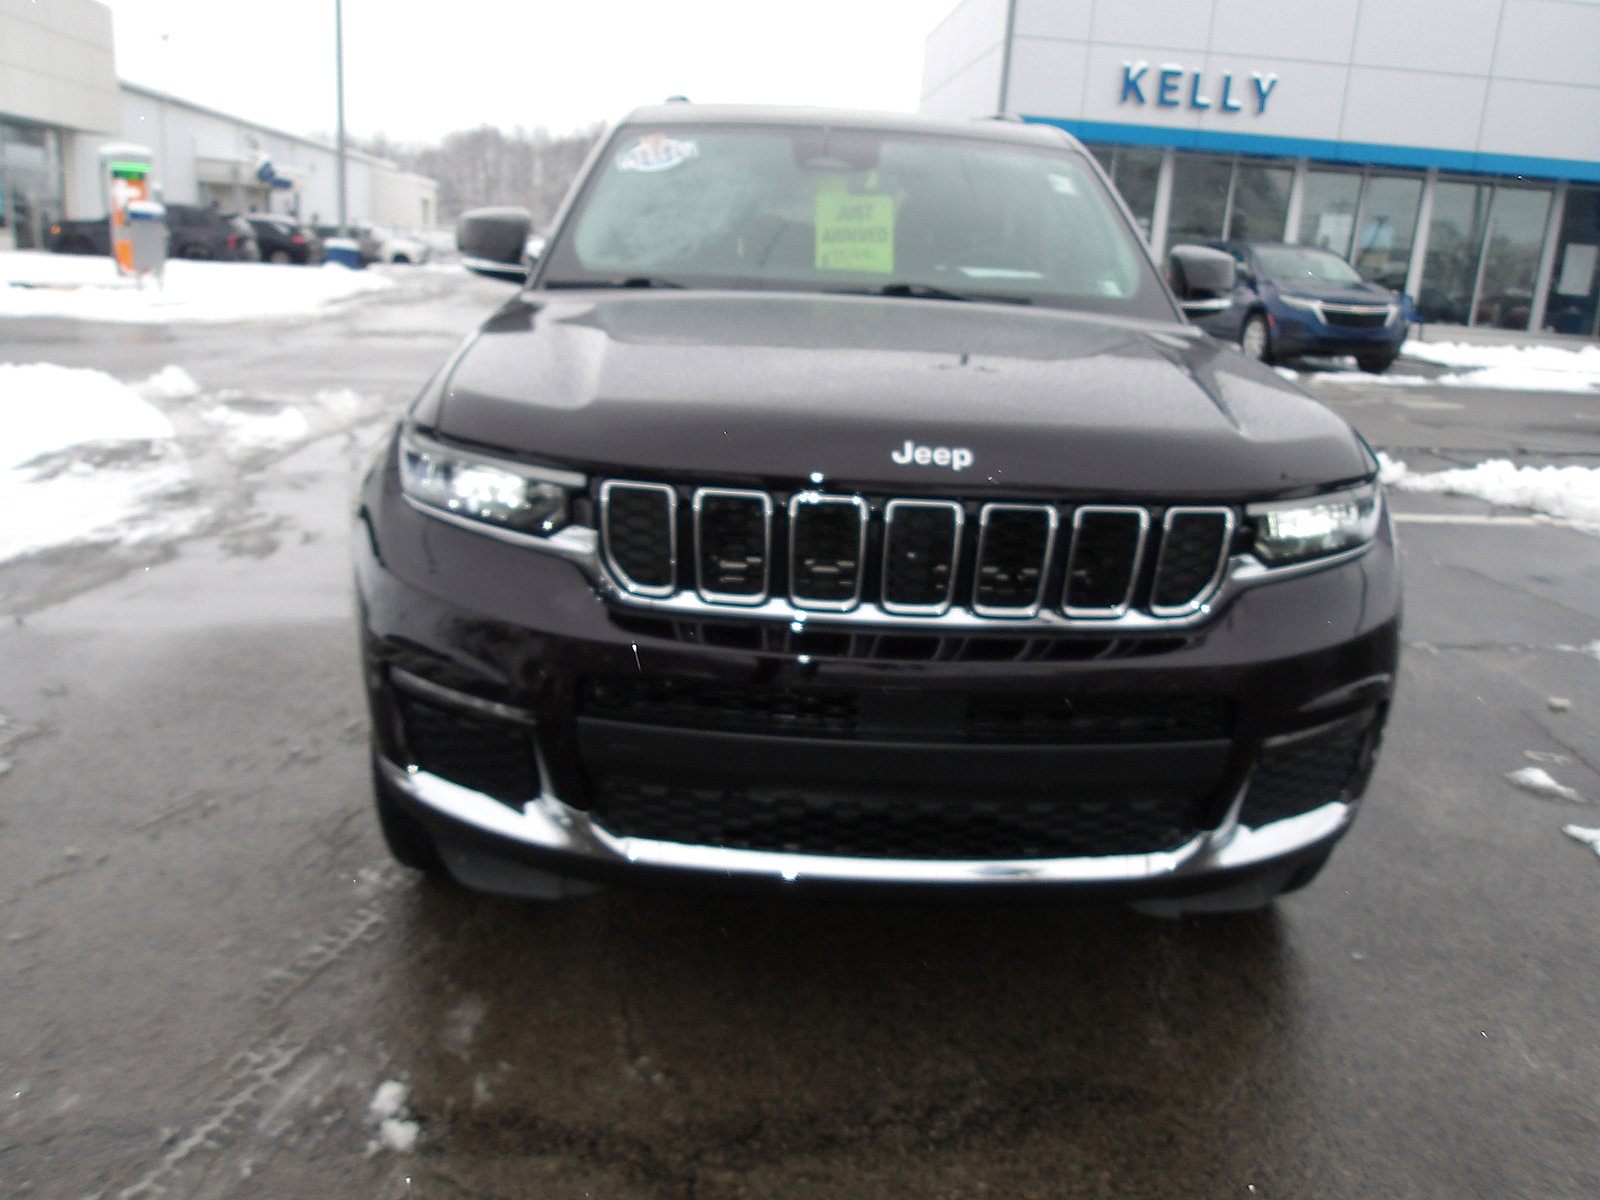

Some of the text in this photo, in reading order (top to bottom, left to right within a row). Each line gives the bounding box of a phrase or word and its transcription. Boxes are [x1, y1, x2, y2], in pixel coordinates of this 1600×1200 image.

[1121, 62, 1278, 114] KELLY
[836, 204, 874, 221] JUST
[822, 227, 889, 243] ARRIVED
[891, 440, 974, 471] Jeep
